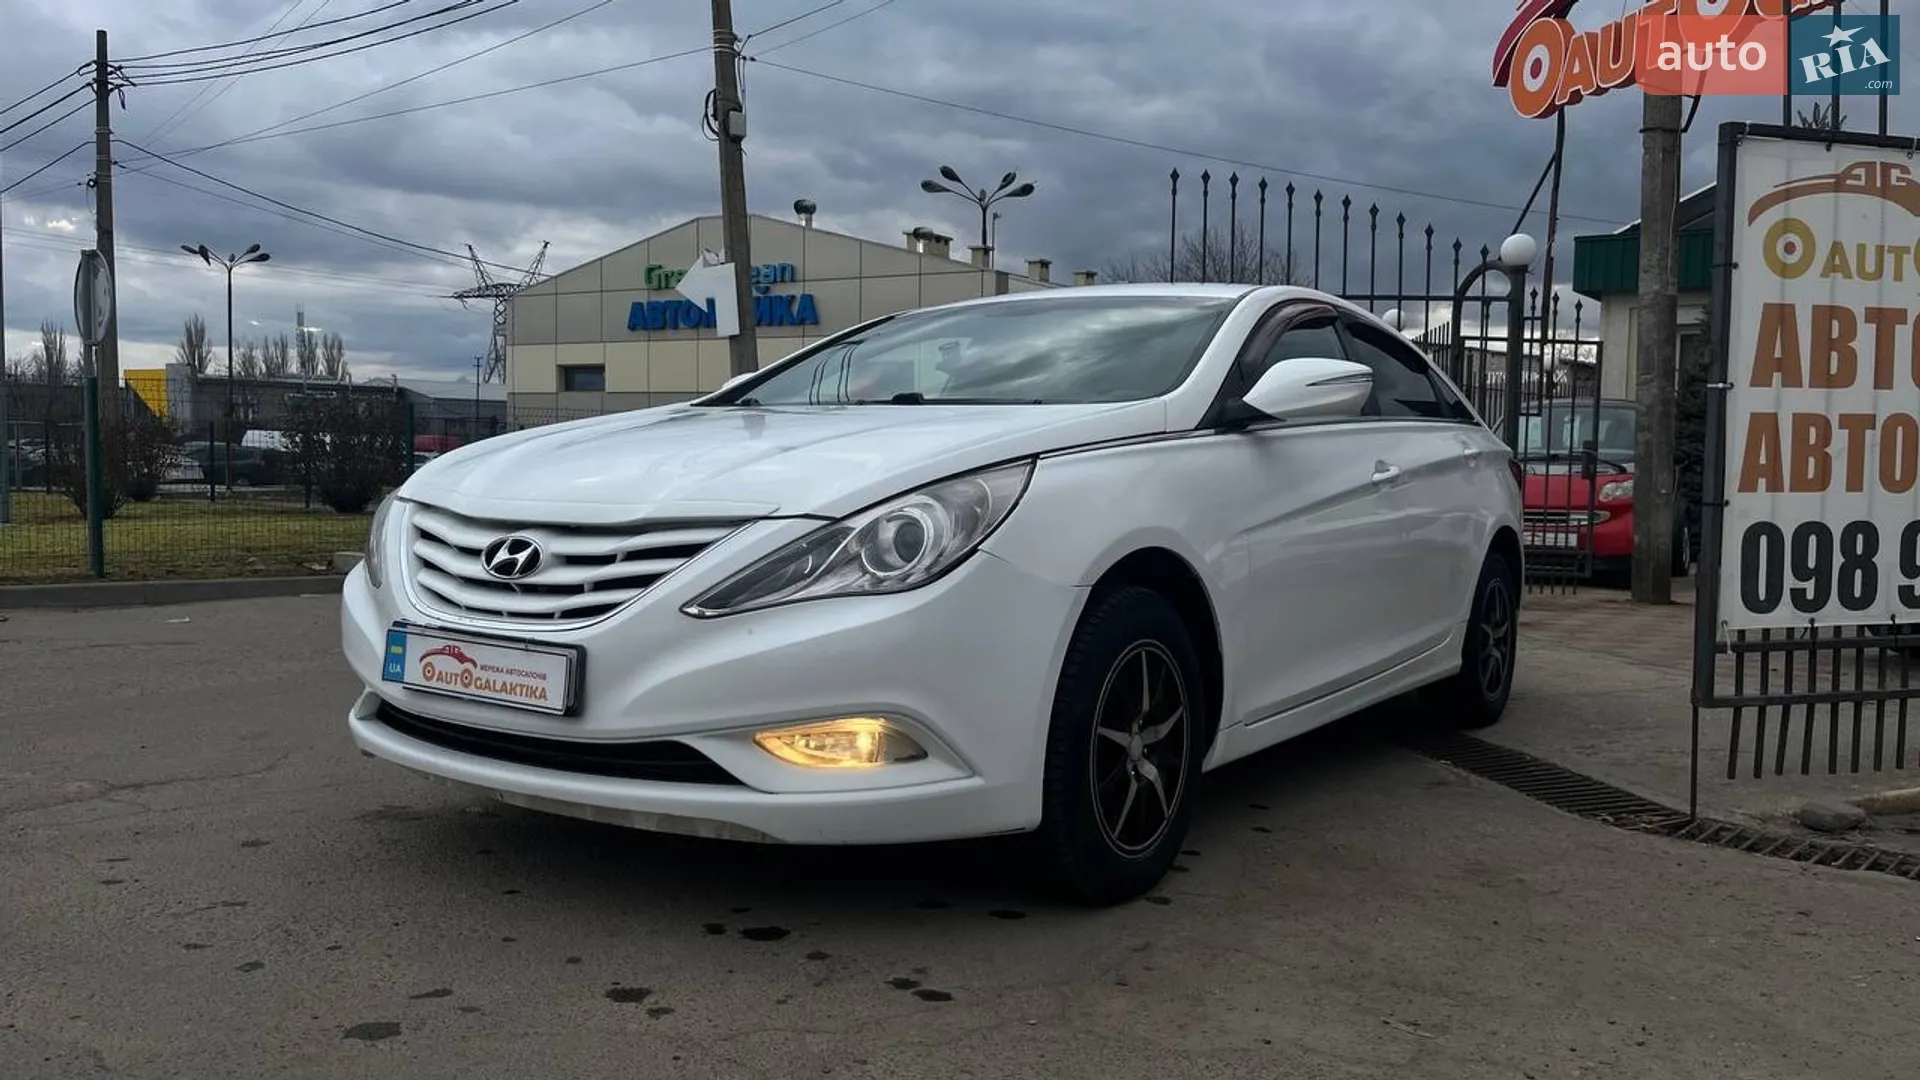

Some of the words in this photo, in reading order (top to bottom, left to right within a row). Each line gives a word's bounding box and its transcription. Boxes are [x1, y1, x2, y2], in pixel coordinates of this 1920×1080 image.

[1763, 217, 1920, 284] OAUT
[1749, 303, 1920, 391] АВТ
[1737, 412, 1920, 494] АВТО
[1740, 520, 1880, 615] 098
[389, 664, 402, 674] UA
